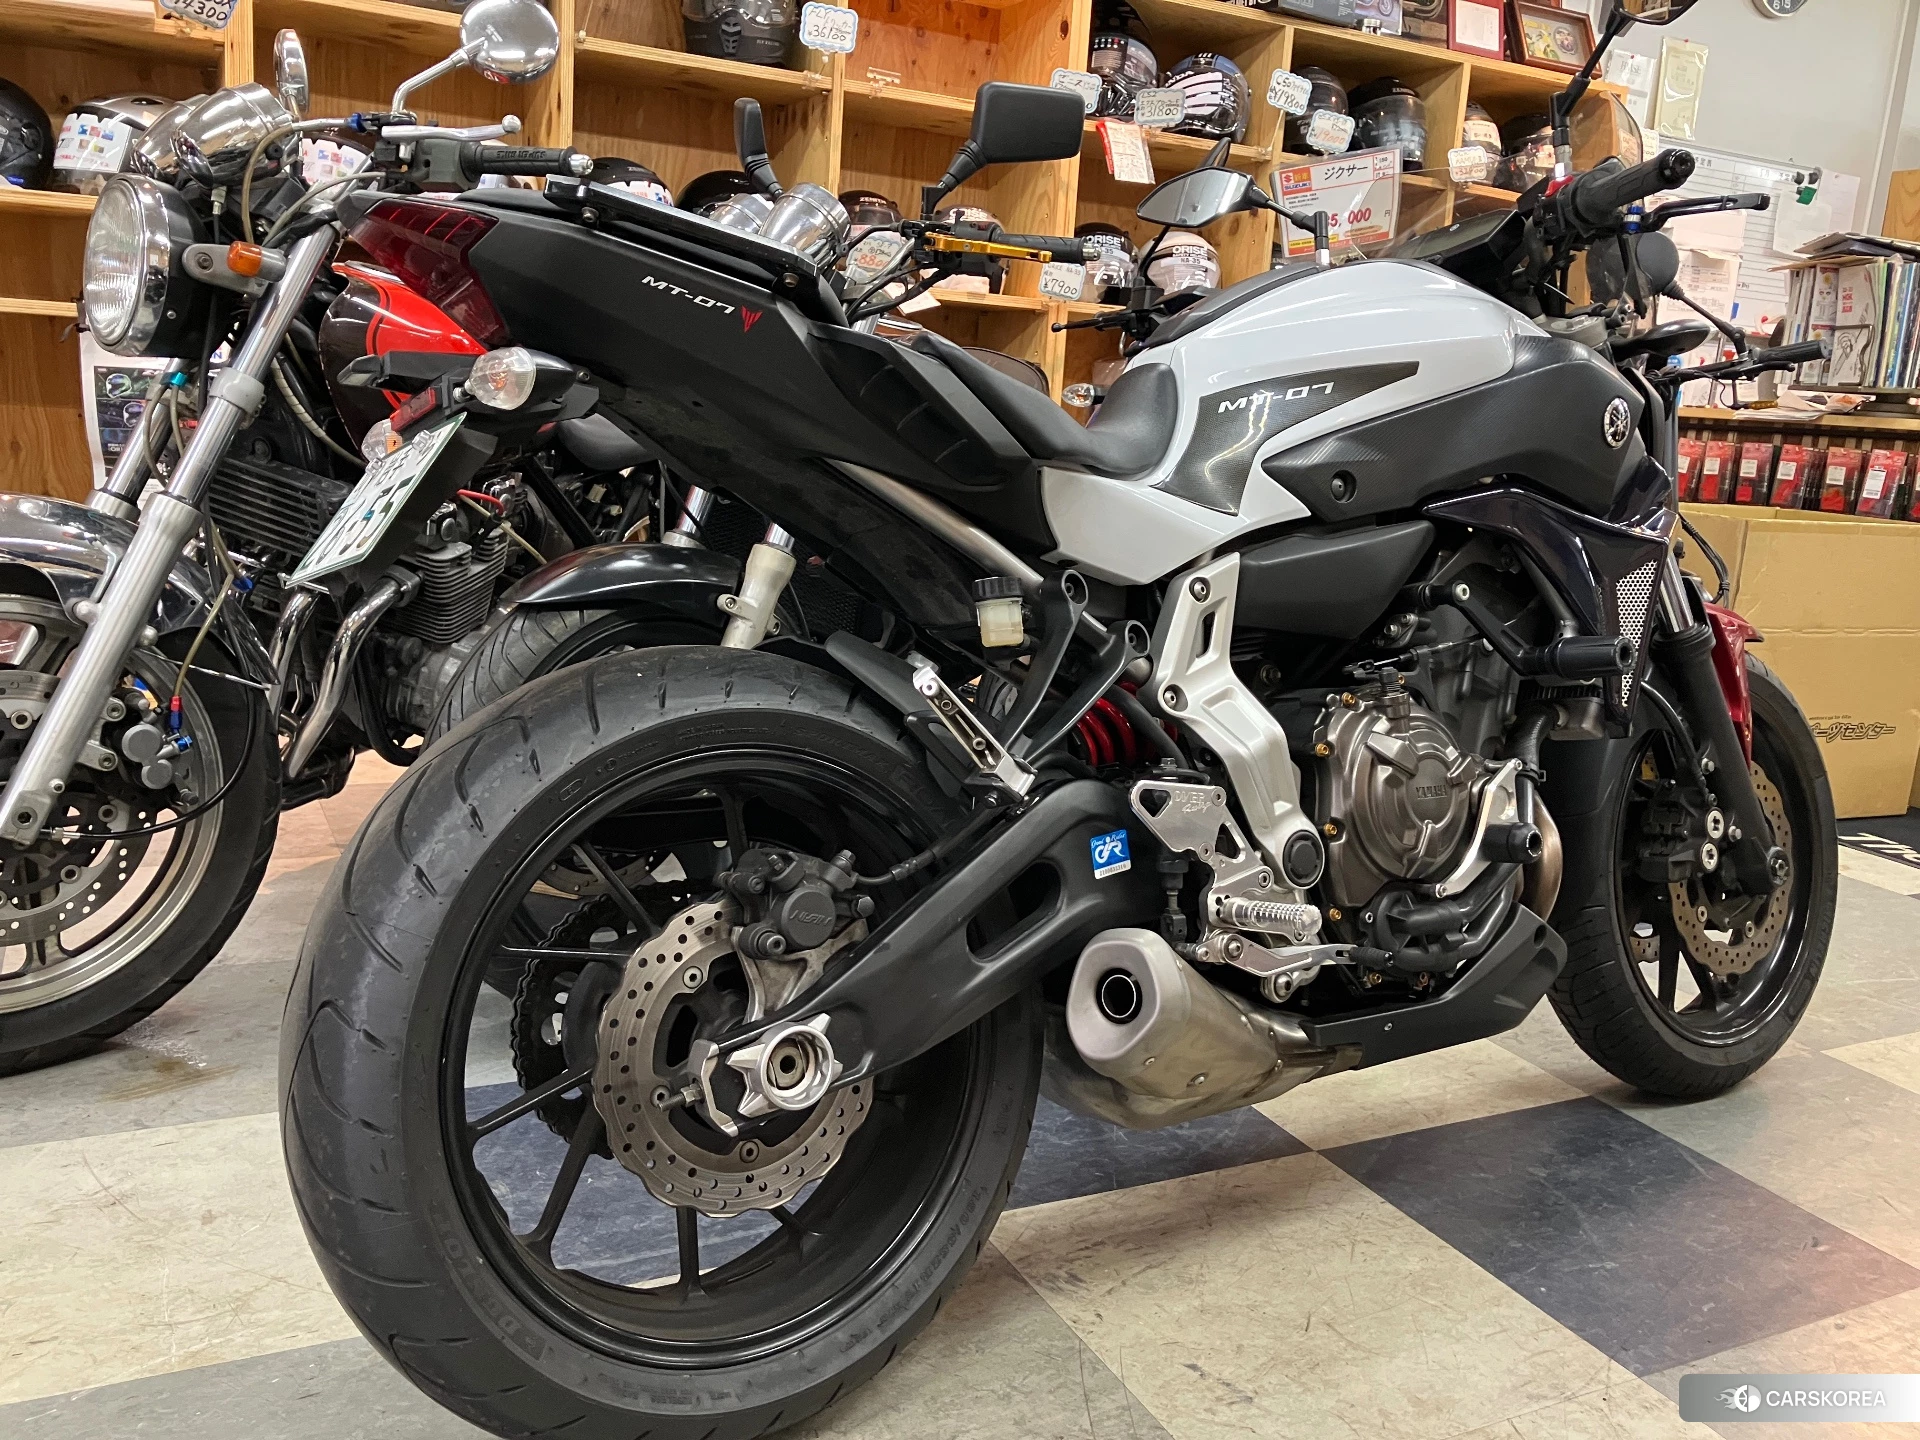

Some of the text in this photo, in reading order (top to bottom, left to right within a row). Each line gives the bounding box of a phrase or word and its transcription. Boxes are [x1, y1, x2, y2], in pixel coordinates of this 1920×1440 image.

[1324, 164, 1369, 181] ジクサー
[1283, 182, 1312, 191] SUZUKI
[1172, 245, 1208, 256] ORISE
[641, 275, 736, 314] MT-07
[1043, 277, 1078, 295] ¥7900
[1217, 381, 1335, 413] MT-07
[1415, 784, 1448, 799] YAMAHA
